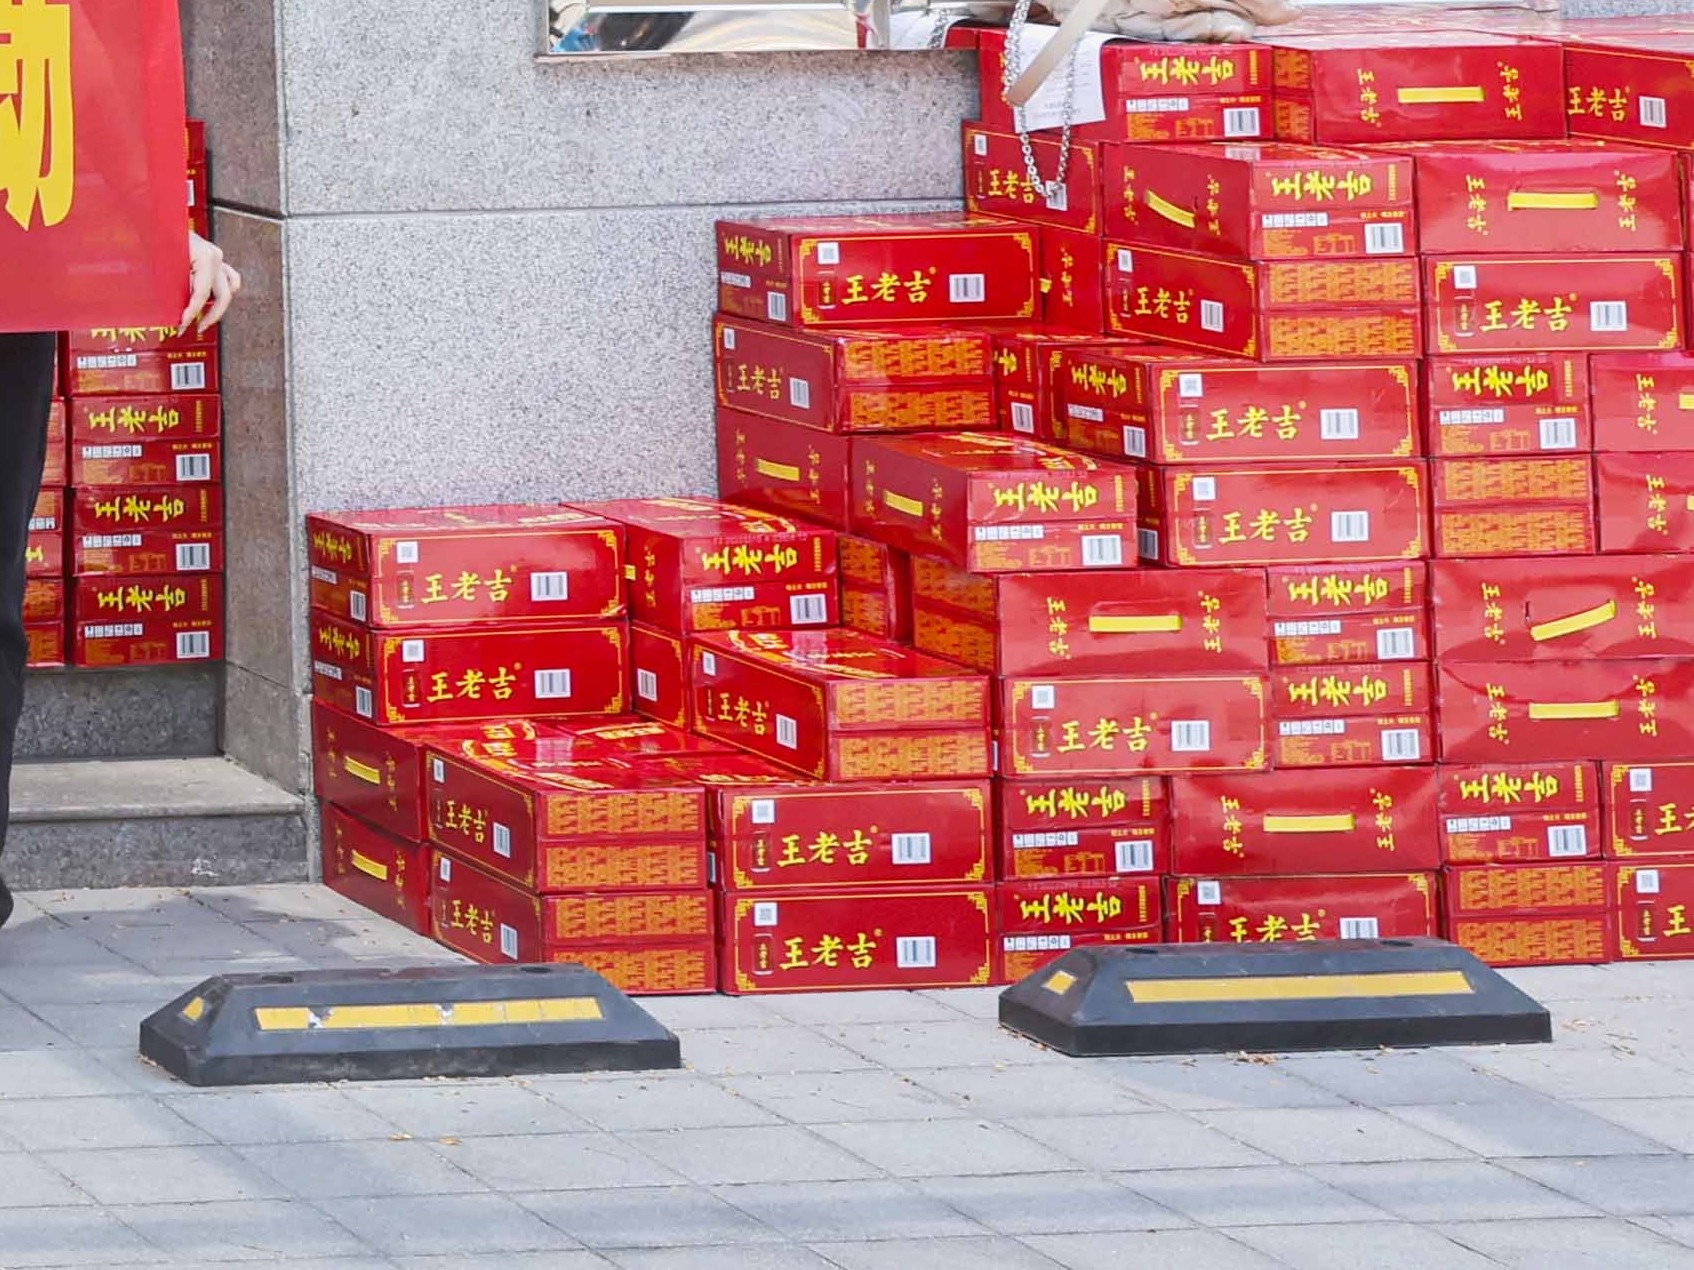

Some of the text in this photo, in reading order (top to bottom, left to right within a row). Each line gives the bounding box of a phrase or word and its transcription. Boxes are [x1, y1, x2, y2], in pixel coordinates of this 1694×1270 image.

[1141, 57, 1234, 84] 王老吉
[1569, 87, 1627, 121] 王老吉
[1272, 171, 1374, 201] 王老吉
[843, 271, 931, 305] 王老吉
[1135, 286, 1190, 324] 王老吉
[1485, 296, 1573, 331] 王老吉
[741, 369, 780, 398] 王老吉
[1452, 365, 1549, 397] 王老吉
[89, 408, 179, 432] 王老吉
[1208, 402, 1307, 440] 王老吉
[94, 497, 184, 520] 王老吉
[1222, 508, 1310, 543] 王老吉
[702, 545, 798, 574] 王老吉
[97, 587, 185, 611] 王老吉
[426, 569, 513, 602] 王老吉
[1288, 575, 1389, 605] 王老吉
[429, 667, 516, 702] 王老吉
[1289, 675, 1389, 707] 王老吉
[1061, 717, 1151, 753] 王老吉
[1026, 787, 1126, 818] 王老吉
[1460, 773, 1559, 804] 王老吉
[778, 827, 878, 868] 王老吉
[1020, 893, 1121, 923] 王老吉
[781, 930, 882, 970] 王老吉
